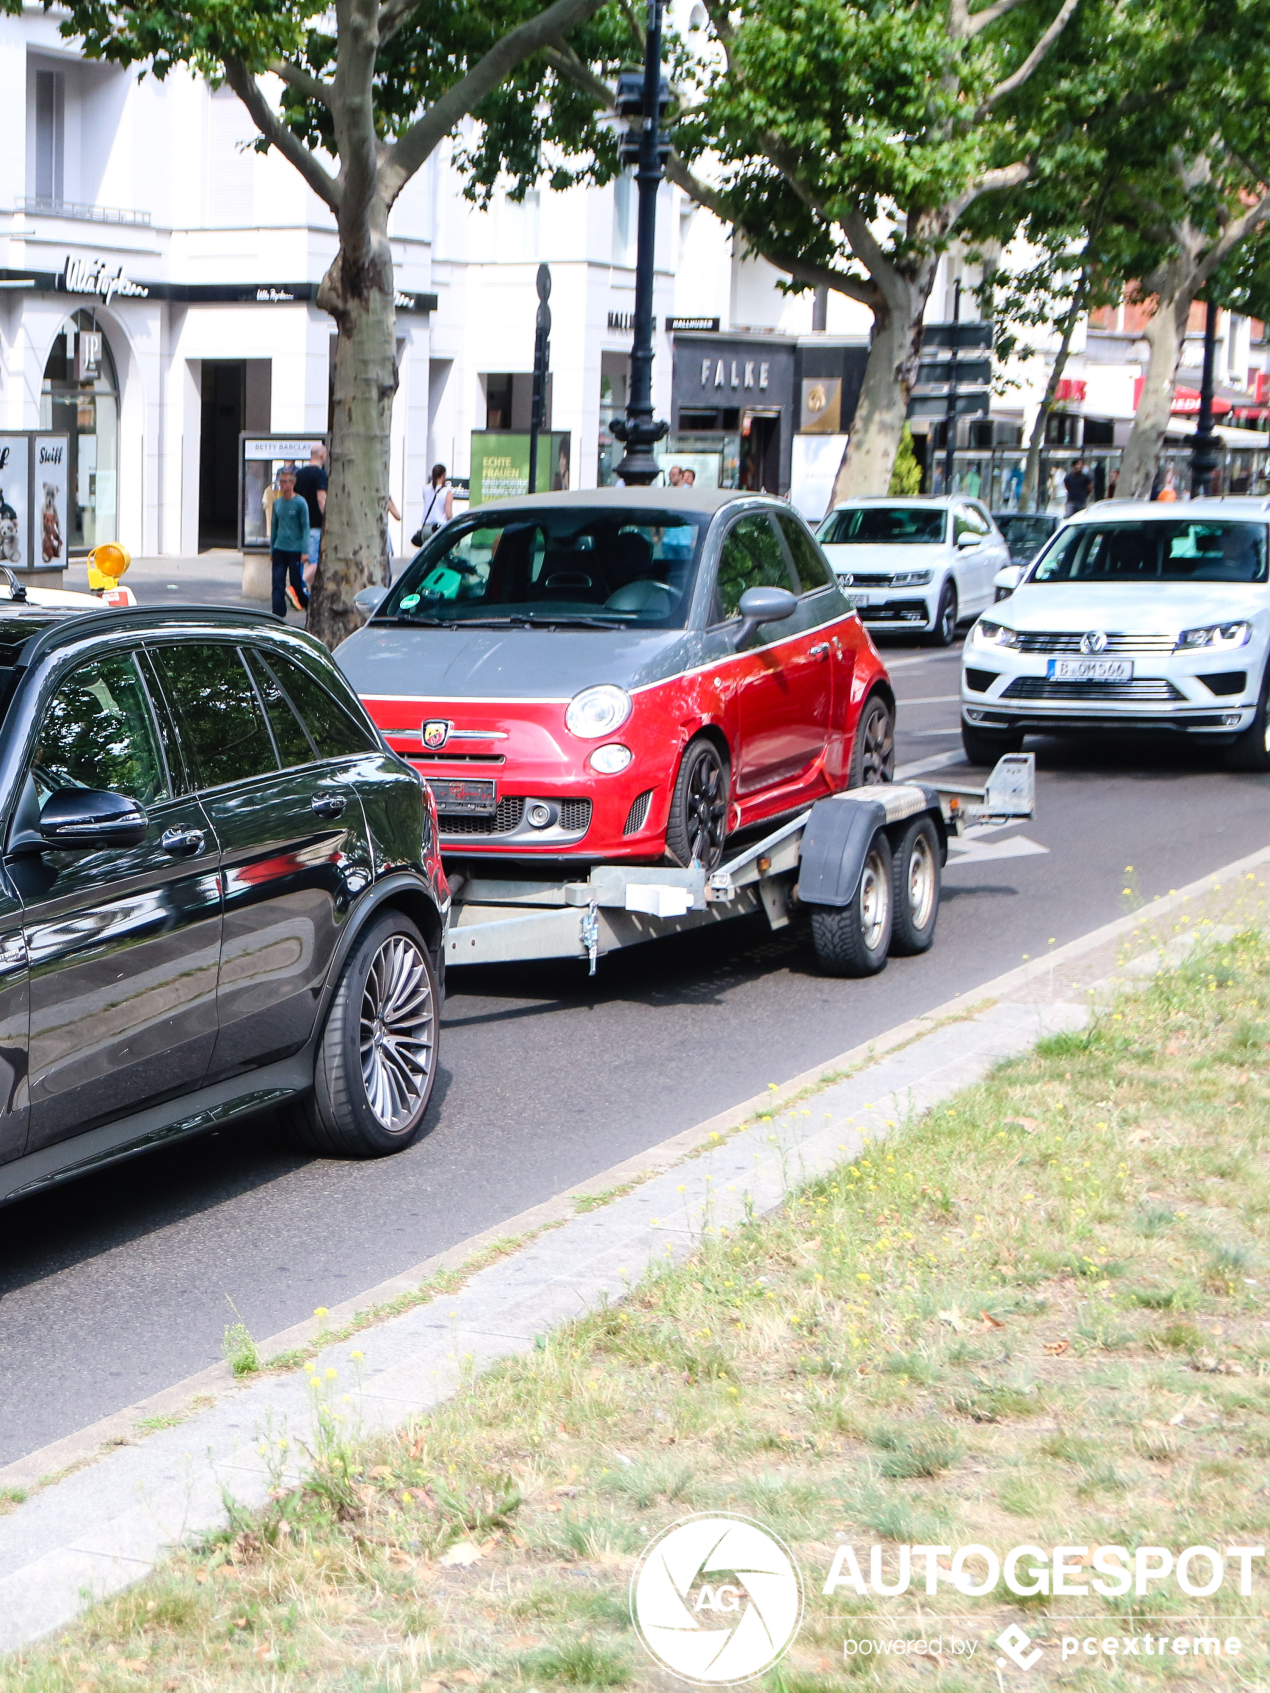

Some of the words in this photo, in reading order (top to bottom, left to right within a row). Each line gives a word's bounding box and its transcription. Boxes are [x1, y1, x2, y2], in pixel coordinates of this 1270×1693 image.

[672, 318, 714, 330] HALLHUBER
[701, 358, 769, 390] FALKE
[39, 446, 64, 465] Steiff
